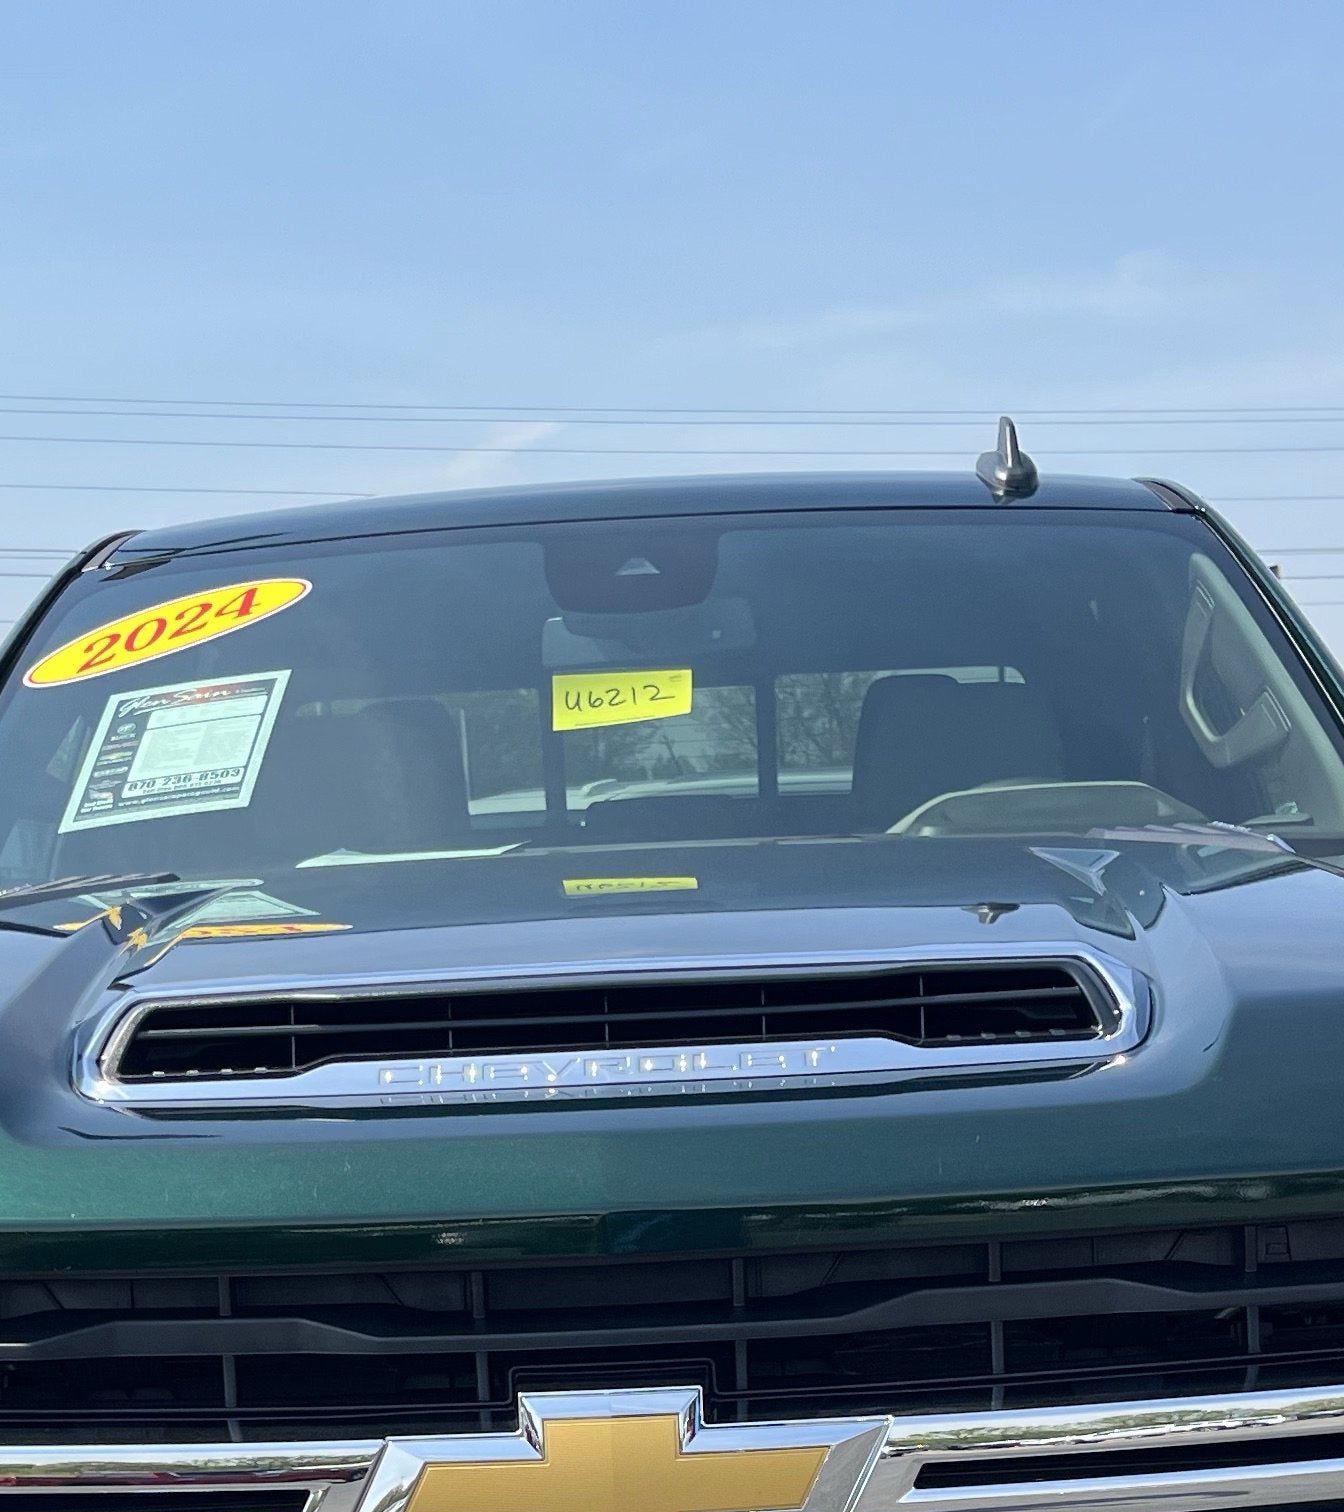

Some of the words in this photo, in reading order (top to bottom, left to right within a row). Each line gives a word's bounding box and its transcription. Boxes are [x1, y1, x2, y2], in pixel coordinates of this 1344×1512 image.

[77, 587, 261, 673] 2024
[118, 694, 171, 717] Glen
[173, 688, 232, 705] Sain
[379, 1045, 836, 1086] CHEVROLET
